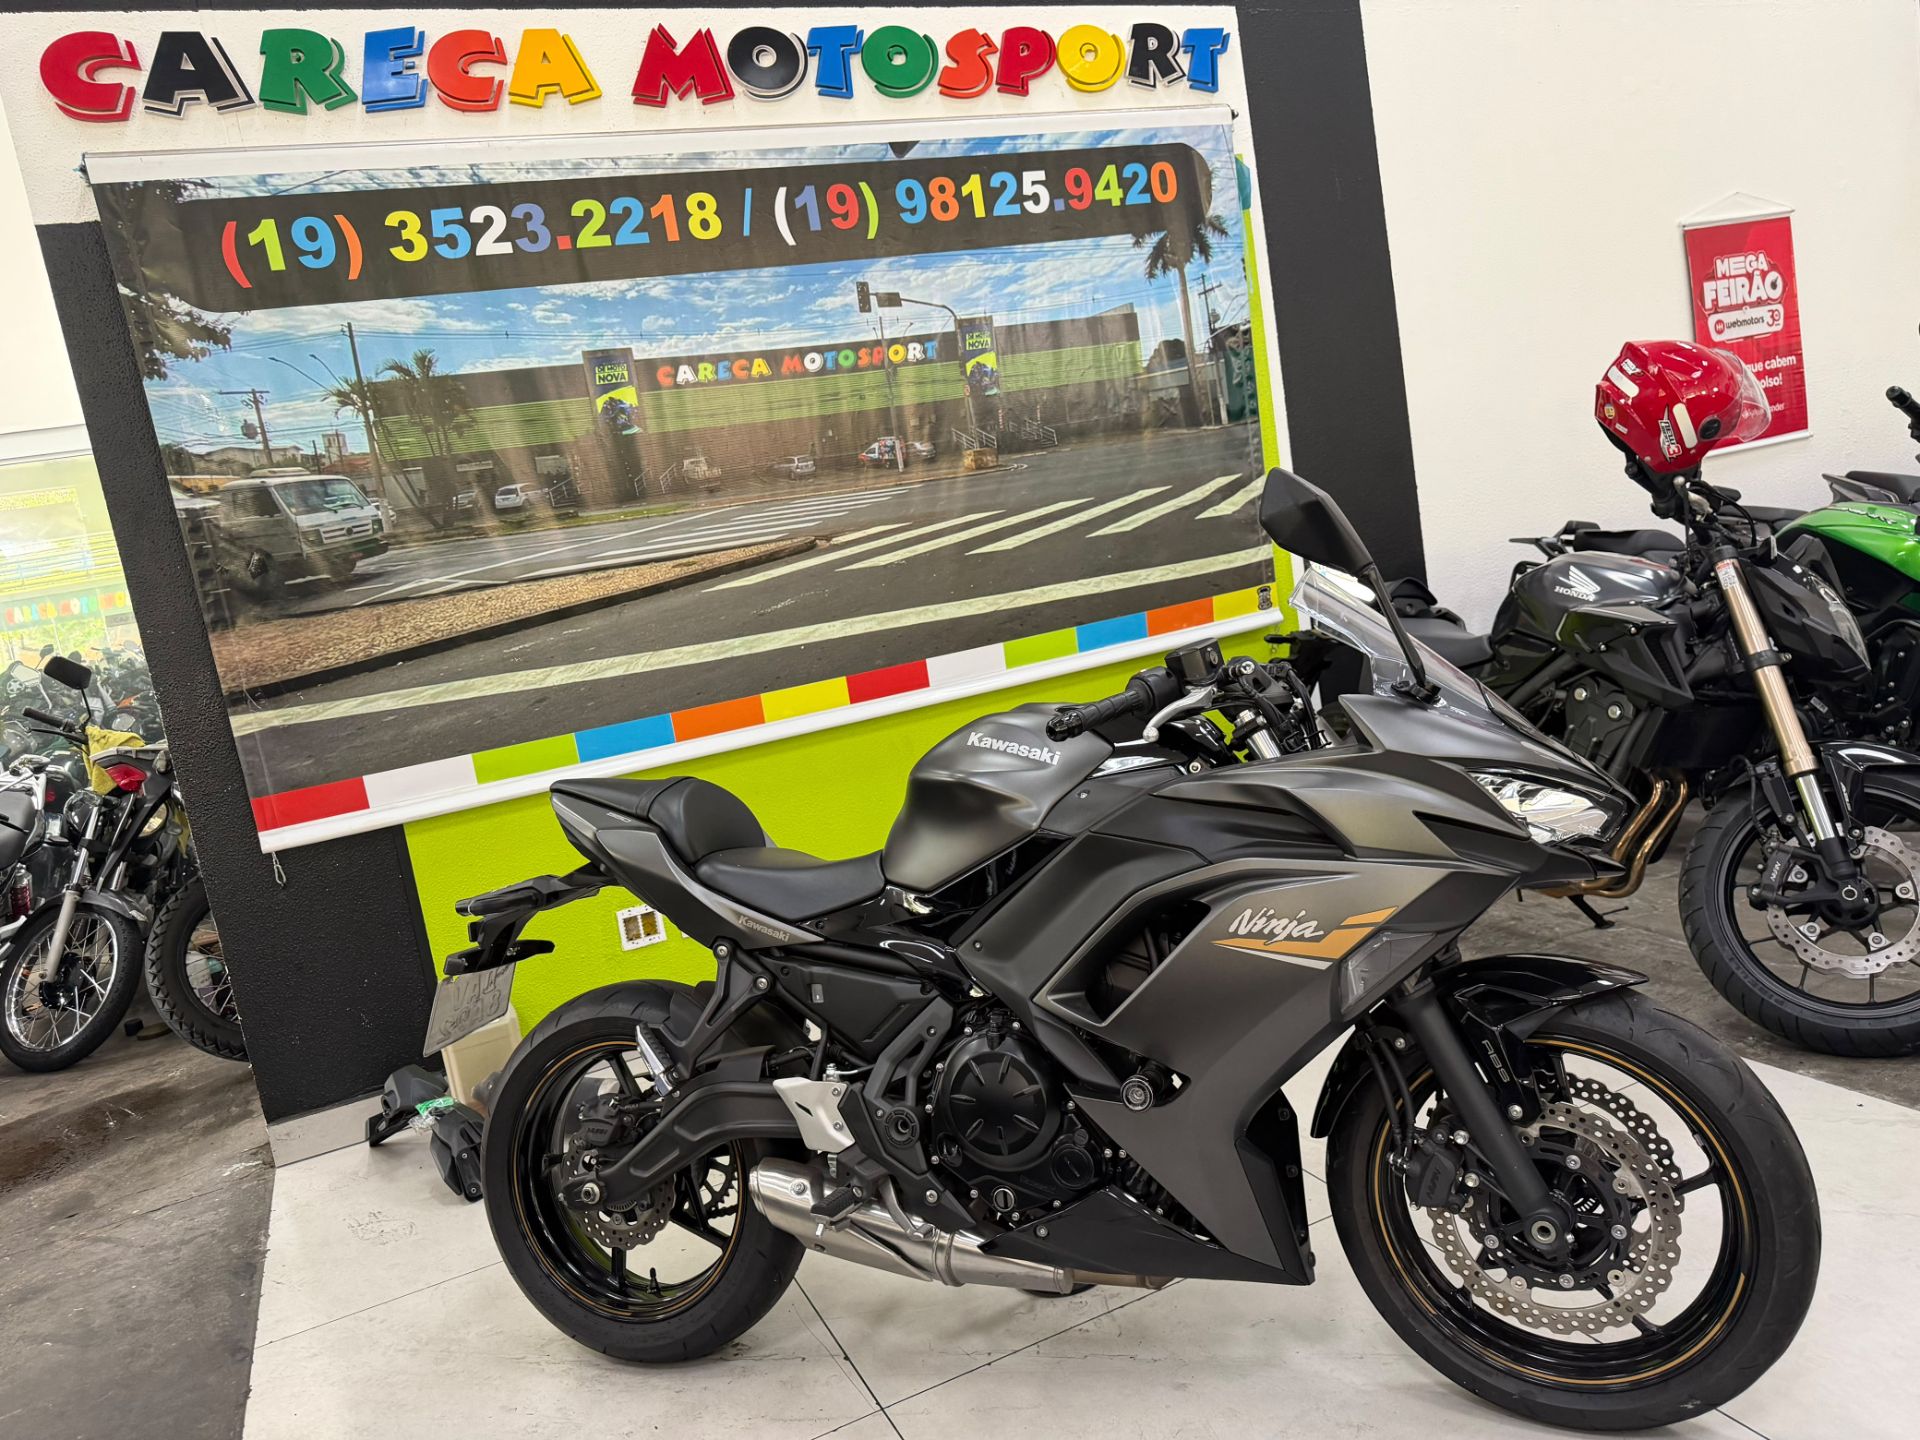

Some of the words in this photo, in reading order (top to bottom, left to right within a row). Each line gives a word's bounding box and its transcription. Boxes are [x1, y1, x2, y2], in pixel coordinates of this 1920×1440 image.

[40, 26, 602, 123] CARECA
[631, 22, 1229, 108] MOTOSPORT
[221, 213, 363, 288] (19)
[384, 192, 722, 263] 3523.2218
[742, 188, 752, 236] /
[773, 182, 879, 246] (19)
[894, 161, 1177, 225] 98125.9420
[1715, 253, 1768, 278] MEGA
[1703, 270, 1783, 309] FEIRÃO
[1726, 316, 1765, 329] webmotors
[968, 339, 991, 349] NOVA
[656, 357, 772, 386] CARECA
[780, 340, 938, 375] MOTOSPORT
[1764, 355, 1797, 370] cabem
[598, 372, 626, 383] NOVA
[1760, 372, 1783, 389] olso!
[1554, 585, 1596, 602] HONDA
[966, 731, 1061, 766] Kawasaki
[739, 915, 790, 942] Kawasaki
[1228, 907, 1324, 946] Ninja
[1481, 1039, 1510, 1083] ABS
